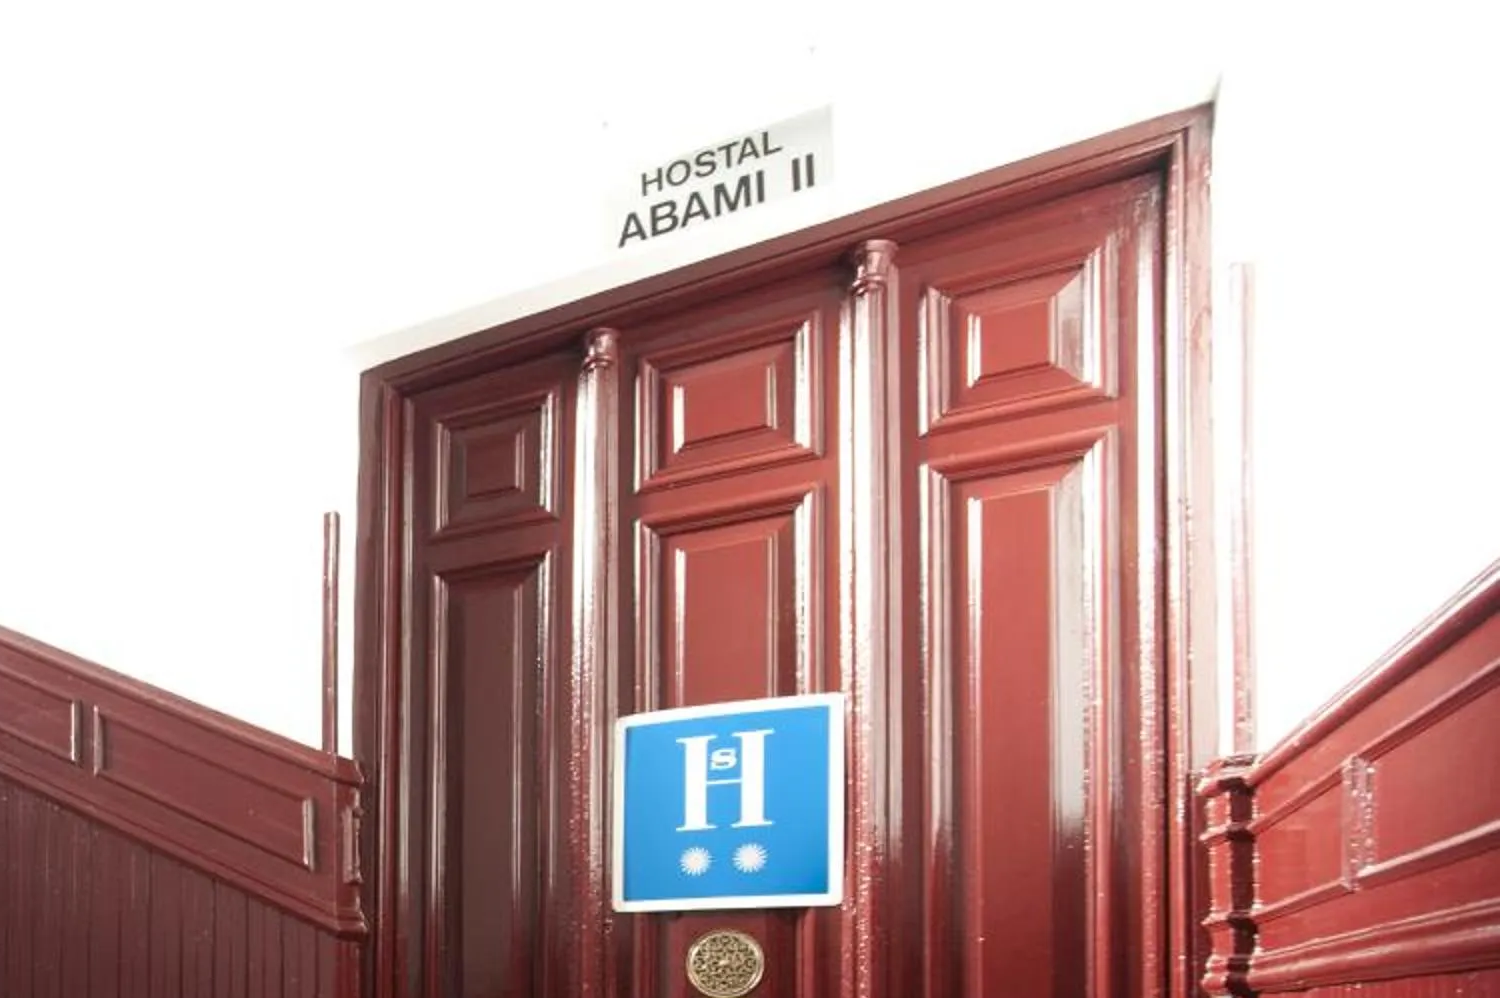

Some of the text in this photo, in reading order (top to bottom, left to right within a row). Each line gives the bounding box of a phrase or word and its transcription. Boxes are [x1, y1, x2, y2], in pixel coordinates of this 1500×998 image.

[618, 153, 815, 248] ABAMI II
[641, 131, 783, 196] HOSTAL
